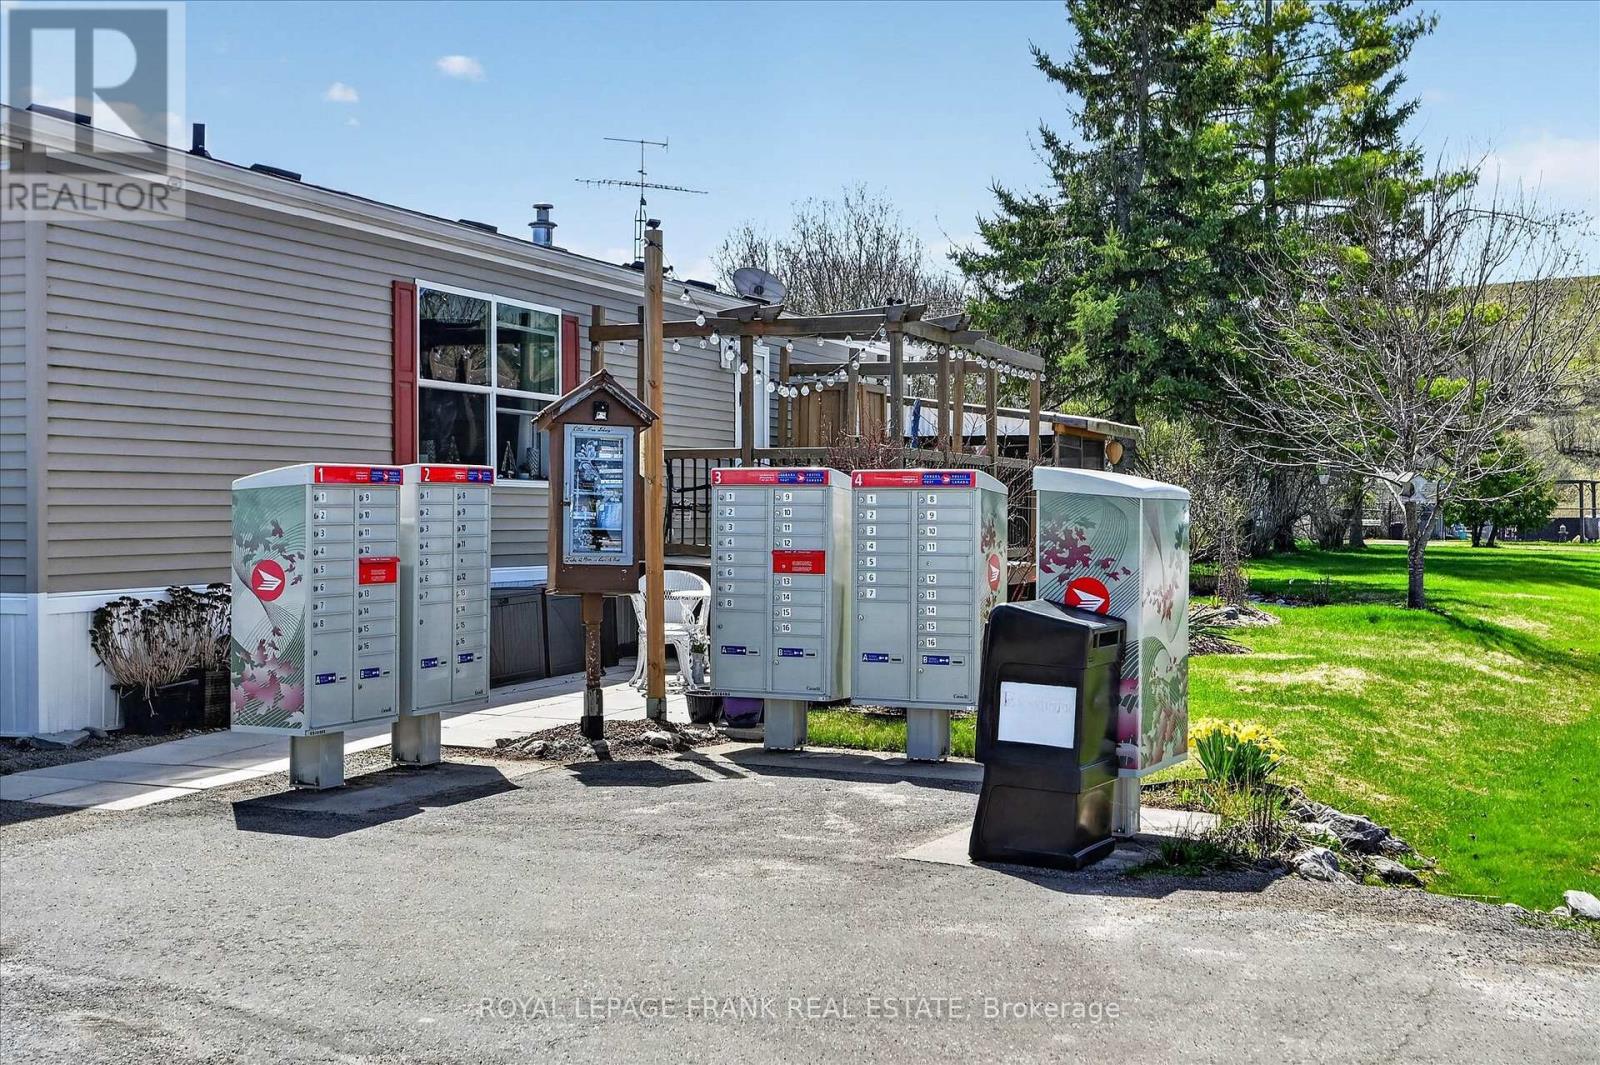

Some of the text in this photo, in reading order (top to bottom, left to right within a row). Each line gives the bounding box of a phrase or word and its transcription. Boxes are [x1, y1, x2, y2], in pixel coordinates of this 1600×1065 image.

[714, 471, 721, 484] 3
[854, 473, 863, 486] 4
[784, 539, 791, 547] 12
[783, 593, 790, 601] 14
[928, 591, 935, 599] 13
[782, 624, 790, 632] 16
